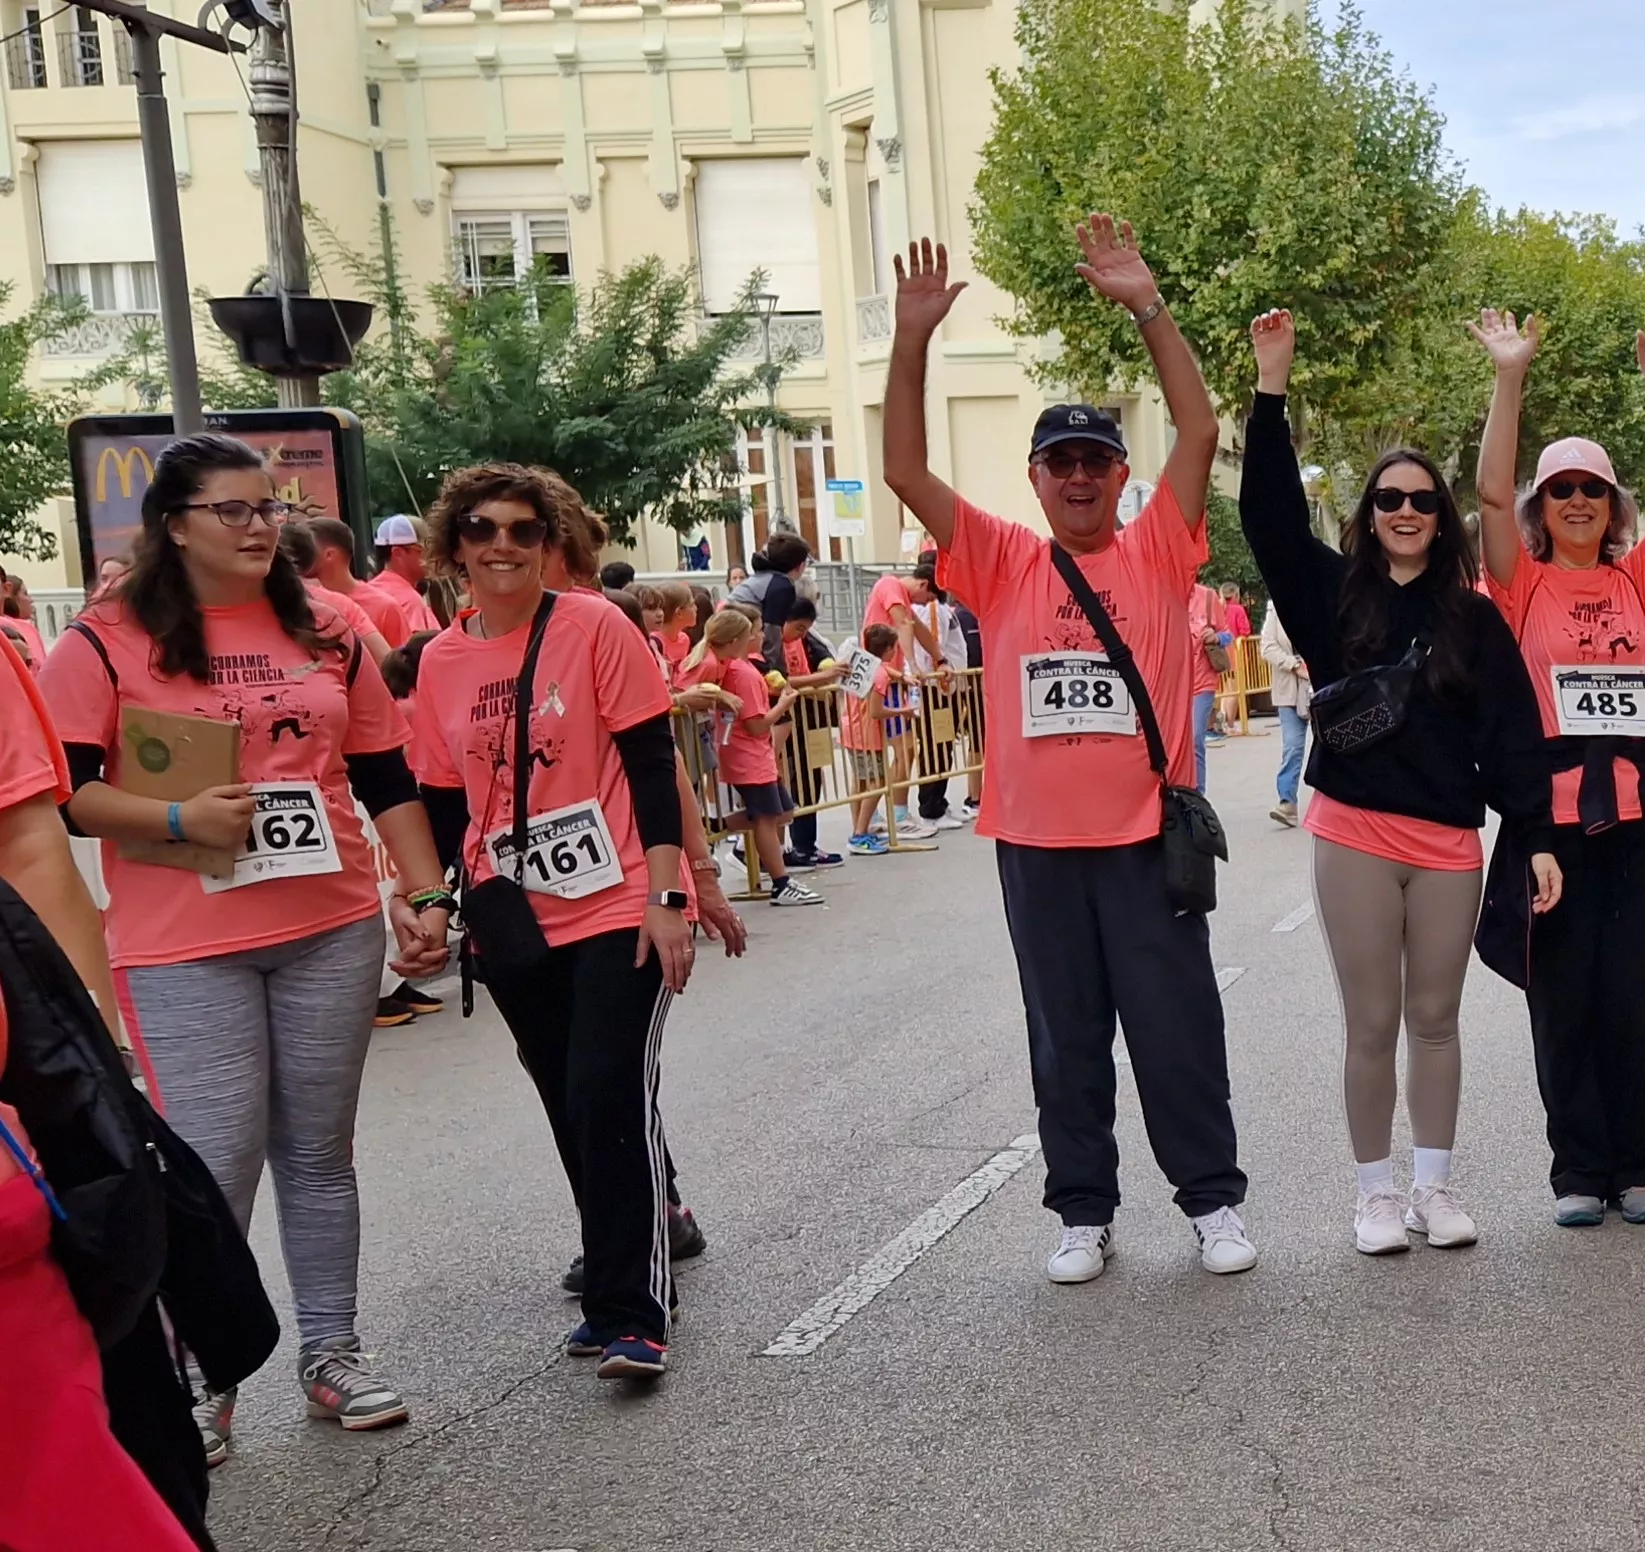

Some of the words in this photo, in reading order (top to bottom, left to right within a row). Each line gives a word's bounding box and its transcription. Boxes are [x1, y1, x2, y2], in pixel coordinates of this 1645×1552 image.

[203, 670, 224, 686] OR
[228, 670, 239, 684] LA
[243, 668, 285, 683] CIENCIA
[849, 656, 871, 690] 3975
[1034, 668, 1072, 678] CONTRA
[1073, 667, 1084, 675] EL
[478, 677, 519, 702] CORRAM
[1044, 679, 1114, 709] 488
[1563, 681, 1599, 689] CONTRA
[1600, 681, 1610, 689] EL
[1612, 679, 1644, 689] CÁNCER
[1576, 692, 1638, 717] 485
[264, 798, 311, 809] CÁNCER
[549, 818, 592, 839] CÁNCER
